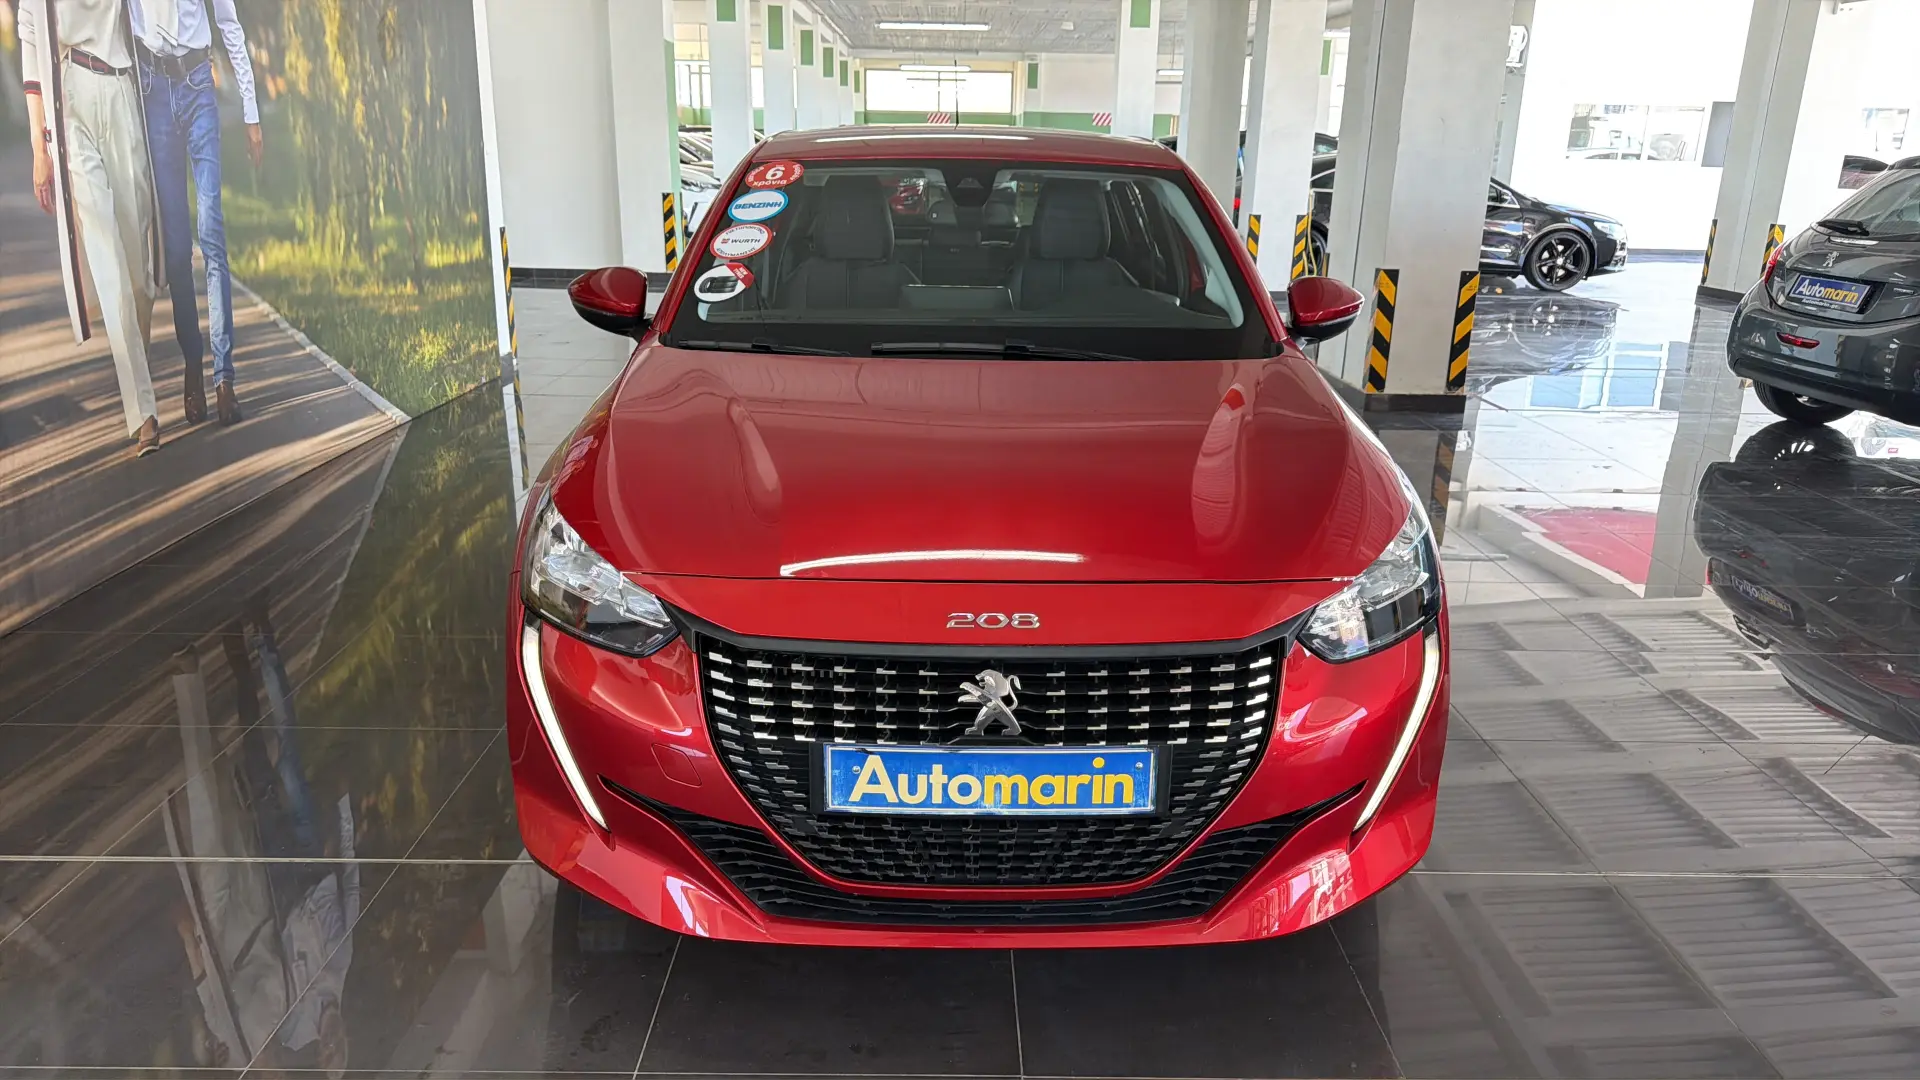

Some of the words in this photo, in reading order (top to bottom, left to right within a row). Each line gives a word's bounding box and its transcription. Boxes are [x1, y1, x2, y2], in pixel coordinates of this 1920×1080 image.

[766, 166, 785, 180] 6
[753, 179, 787, 187] χρόνια
[1796, 278, 1859, 303] Automarin
[946, 612, 1040, 628] 208
[848, 754, 1133, 805] Automarin
